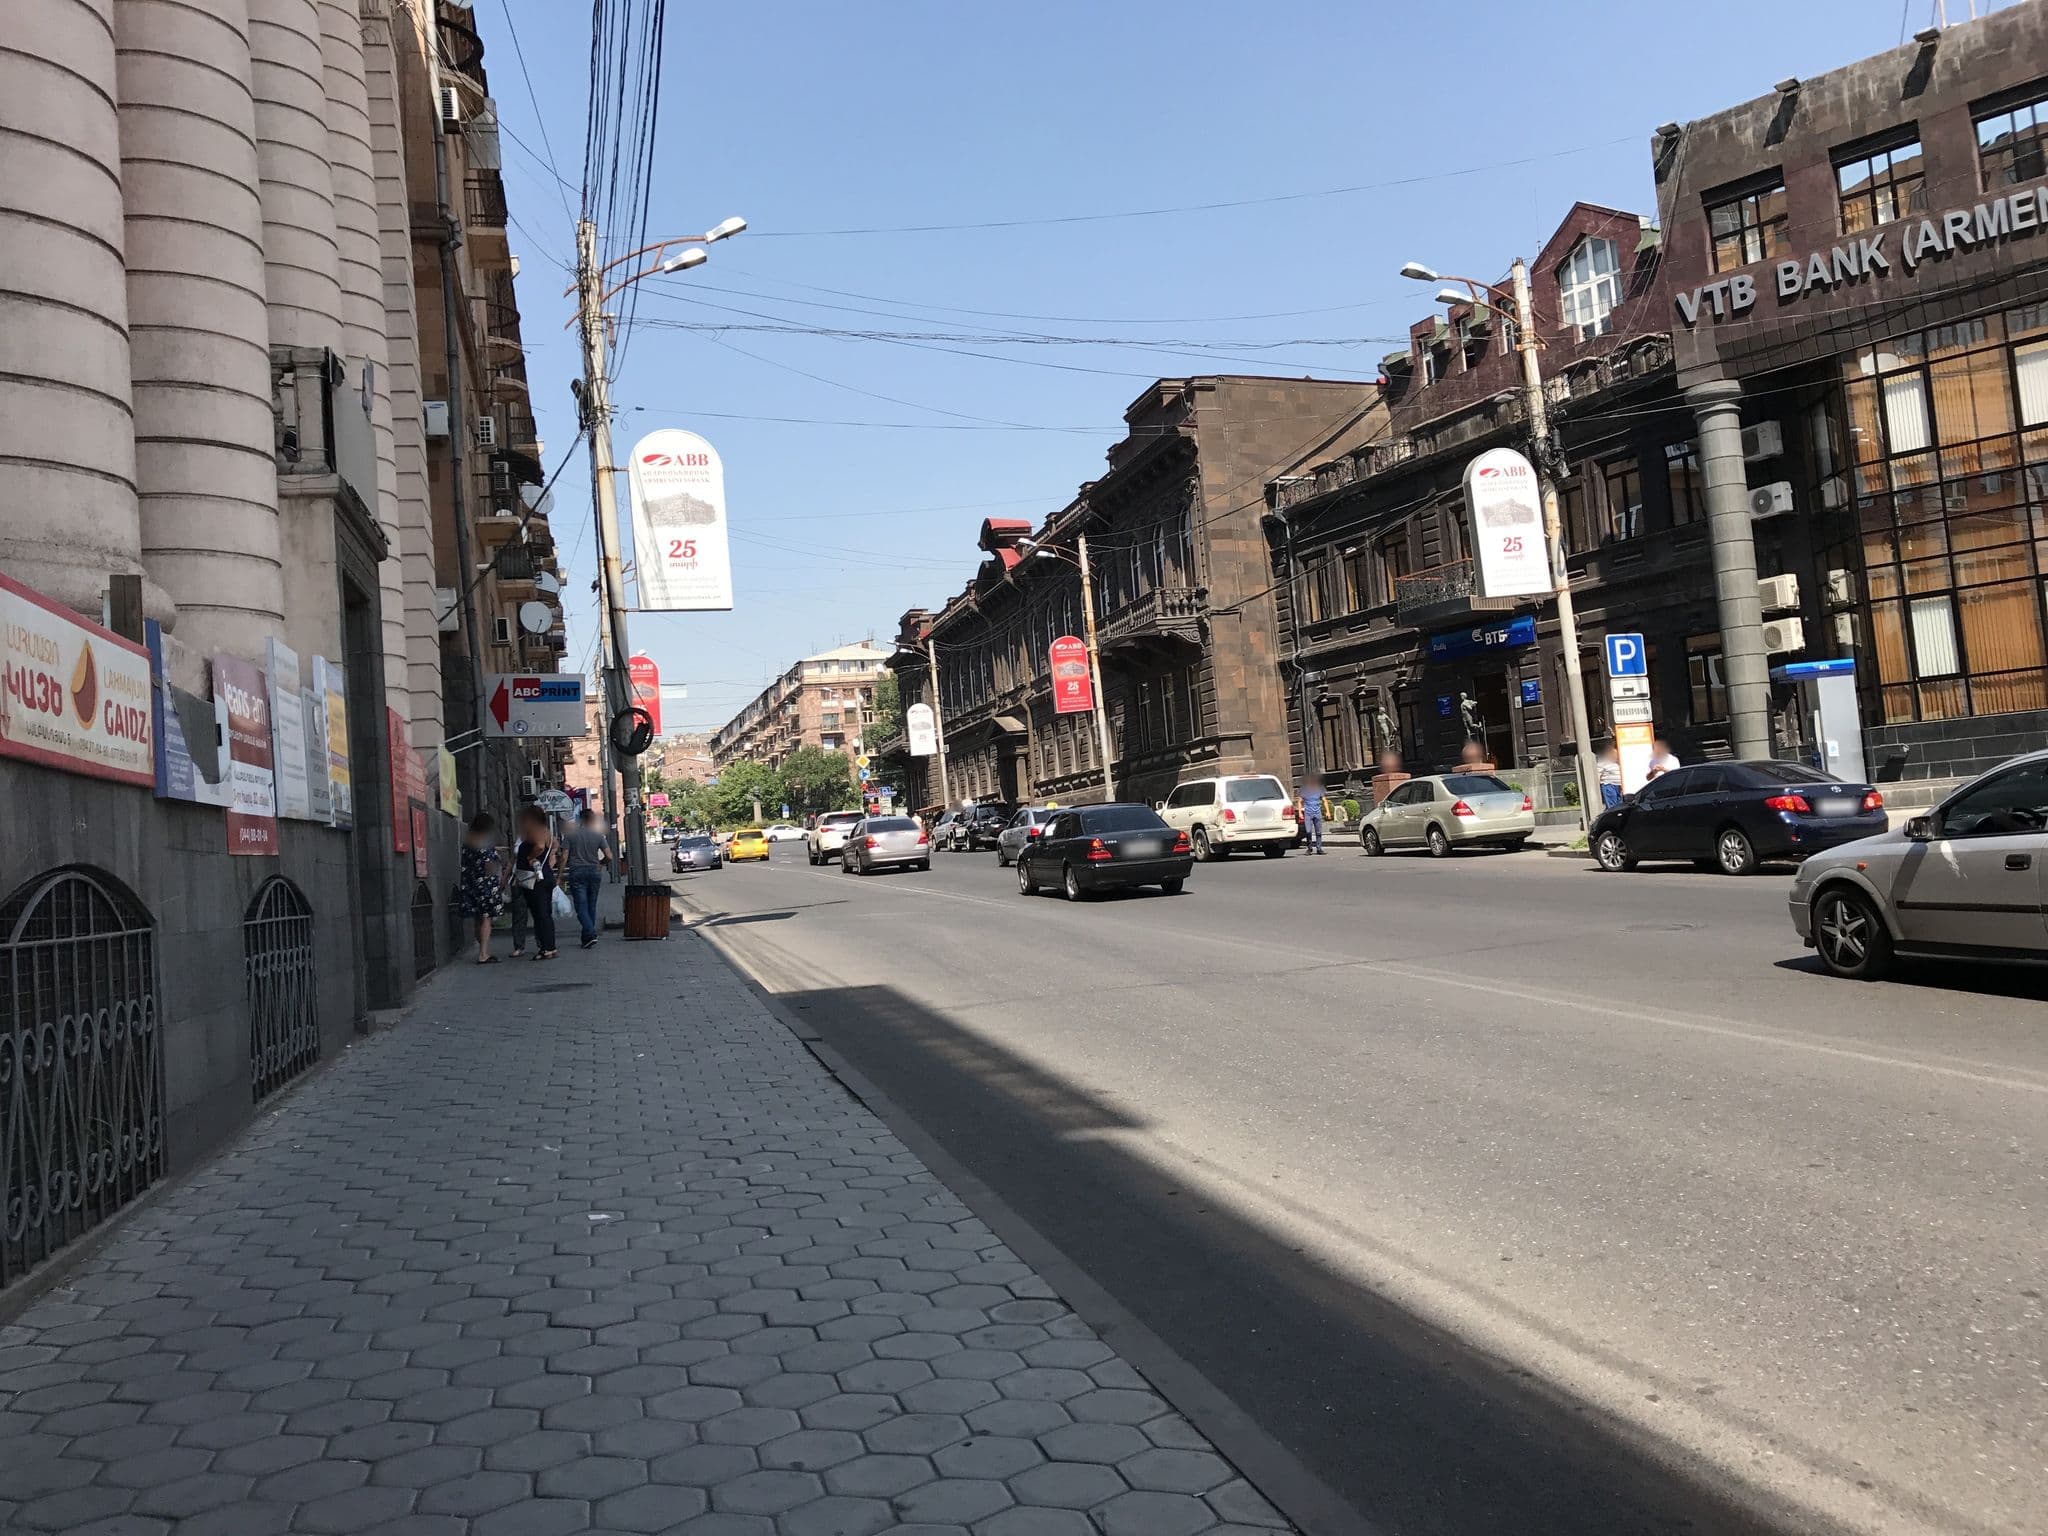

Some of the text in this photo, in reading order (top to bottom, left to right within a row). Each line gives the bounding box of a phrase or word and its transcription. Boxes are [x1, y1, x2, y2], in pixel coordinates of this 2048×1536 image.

[1675, 274, 1757, 322] VTB
[1777, 232, 1890, 297] BANK
[674, 453, 709, 466] ABB
[1503, 465, 1527, 477] ABB
[668, 539, 697, 558] 25
[1503, 536, 1523, 552] 25
[1484, 629, 1508, 645] ВТБ
[1614, 639, 1637, 672] P
[513, 687, 540, 697] ABC
[103, 698, 148, 745] GAIDZ
